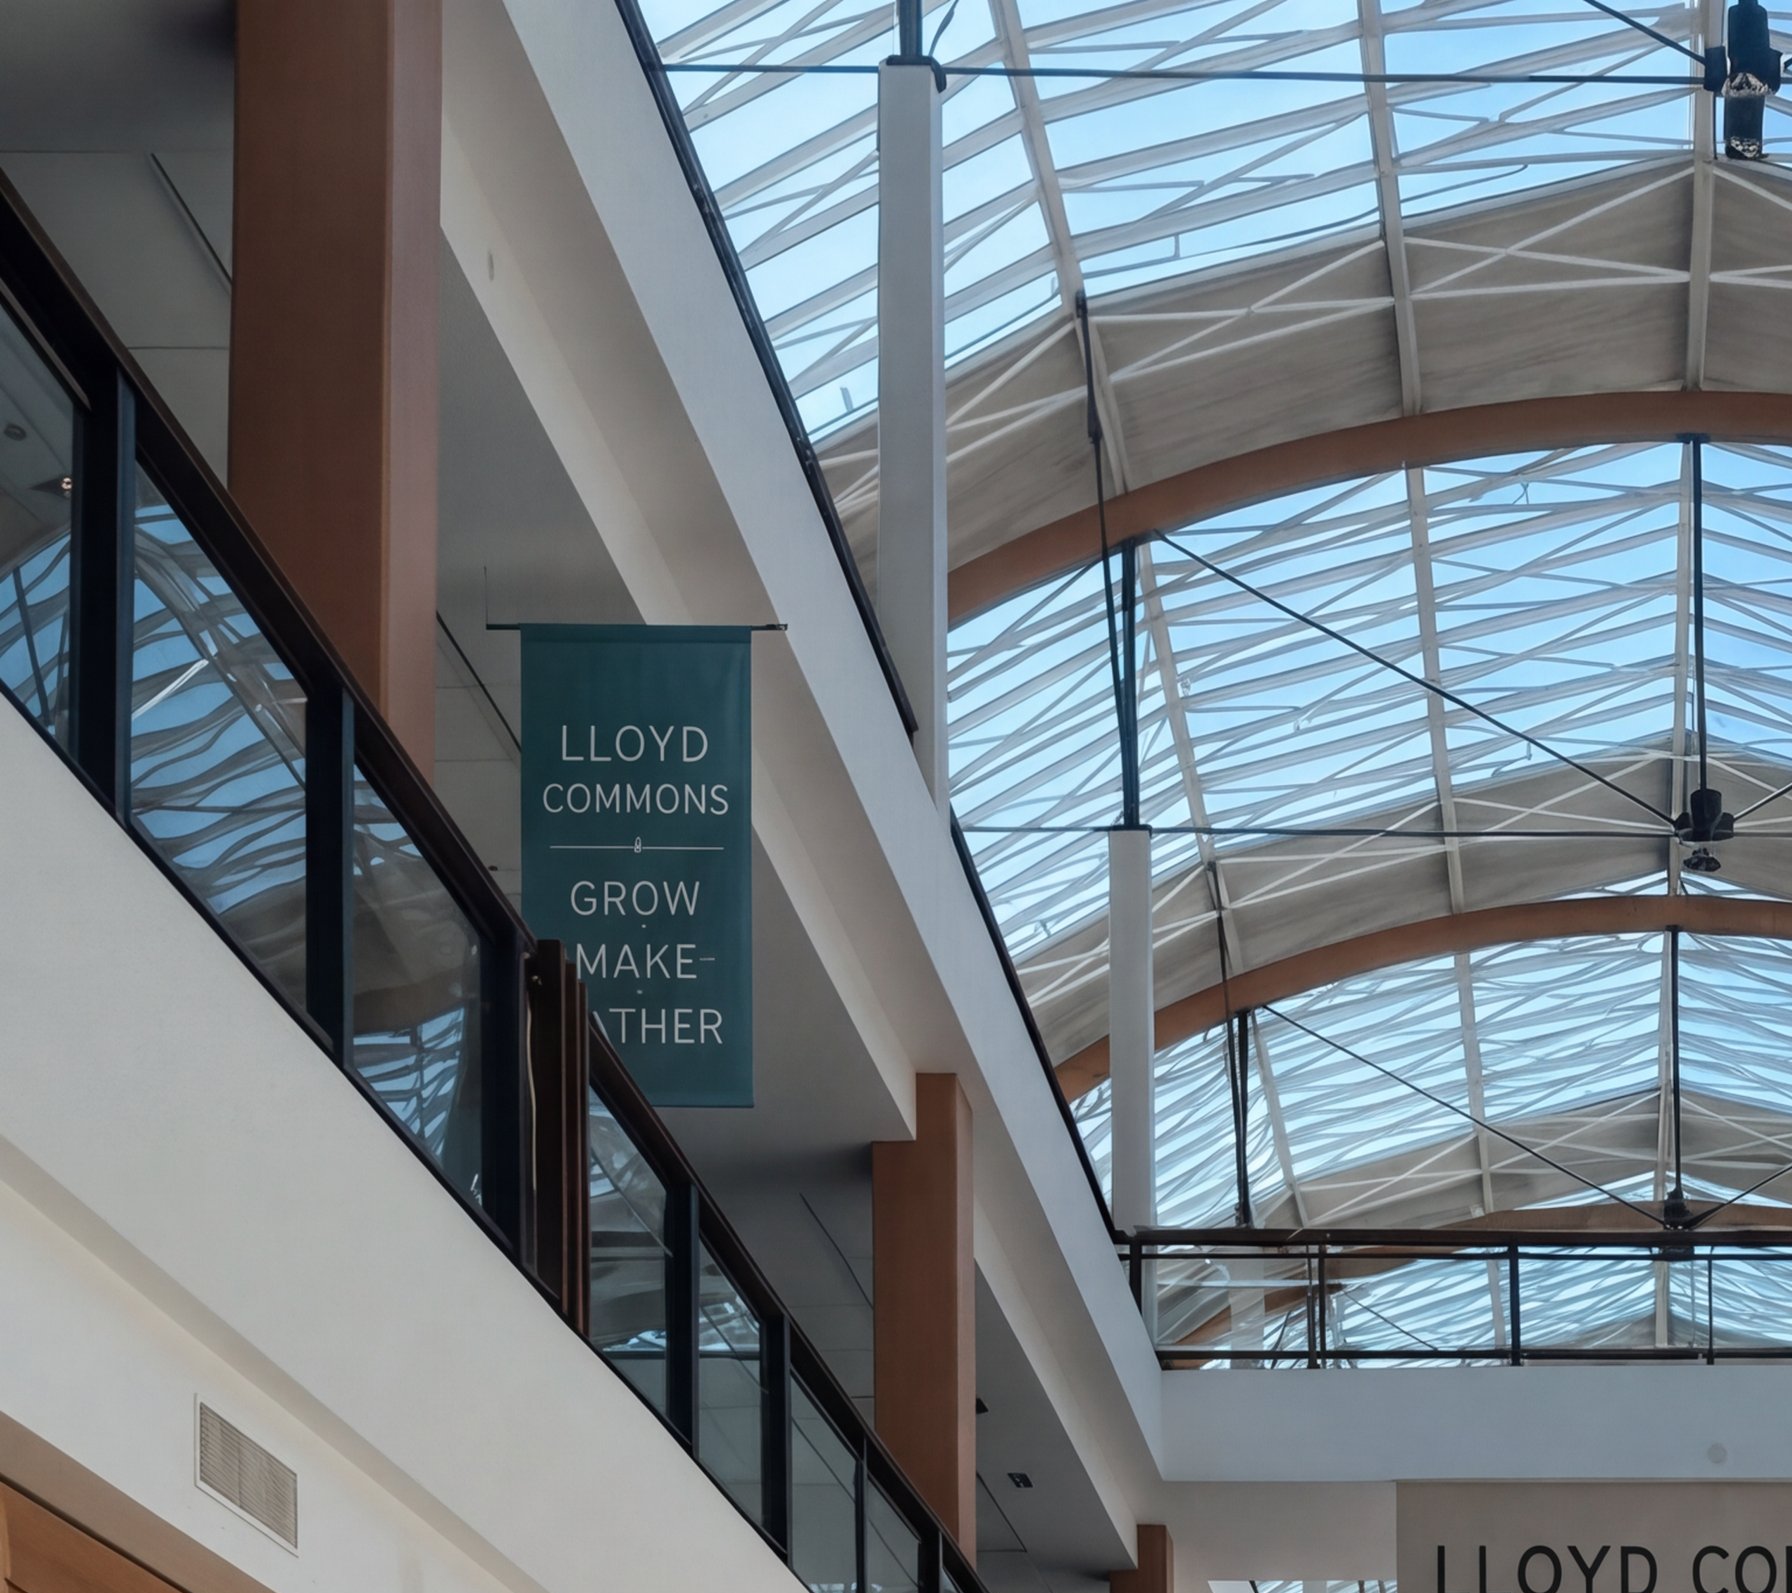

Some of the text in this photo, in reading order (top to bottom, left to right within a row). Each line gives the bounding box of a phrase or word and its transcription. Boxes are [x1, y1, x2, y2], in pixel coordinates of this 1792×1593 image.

[561, 725, 709, 762] LLOYD
[542, 783, 729, 815] COMMONS
[570, 881, 699, 916] GROW
[576, 943, 698, 979] MAKE
[592, 1008, 723, 1044] THER
